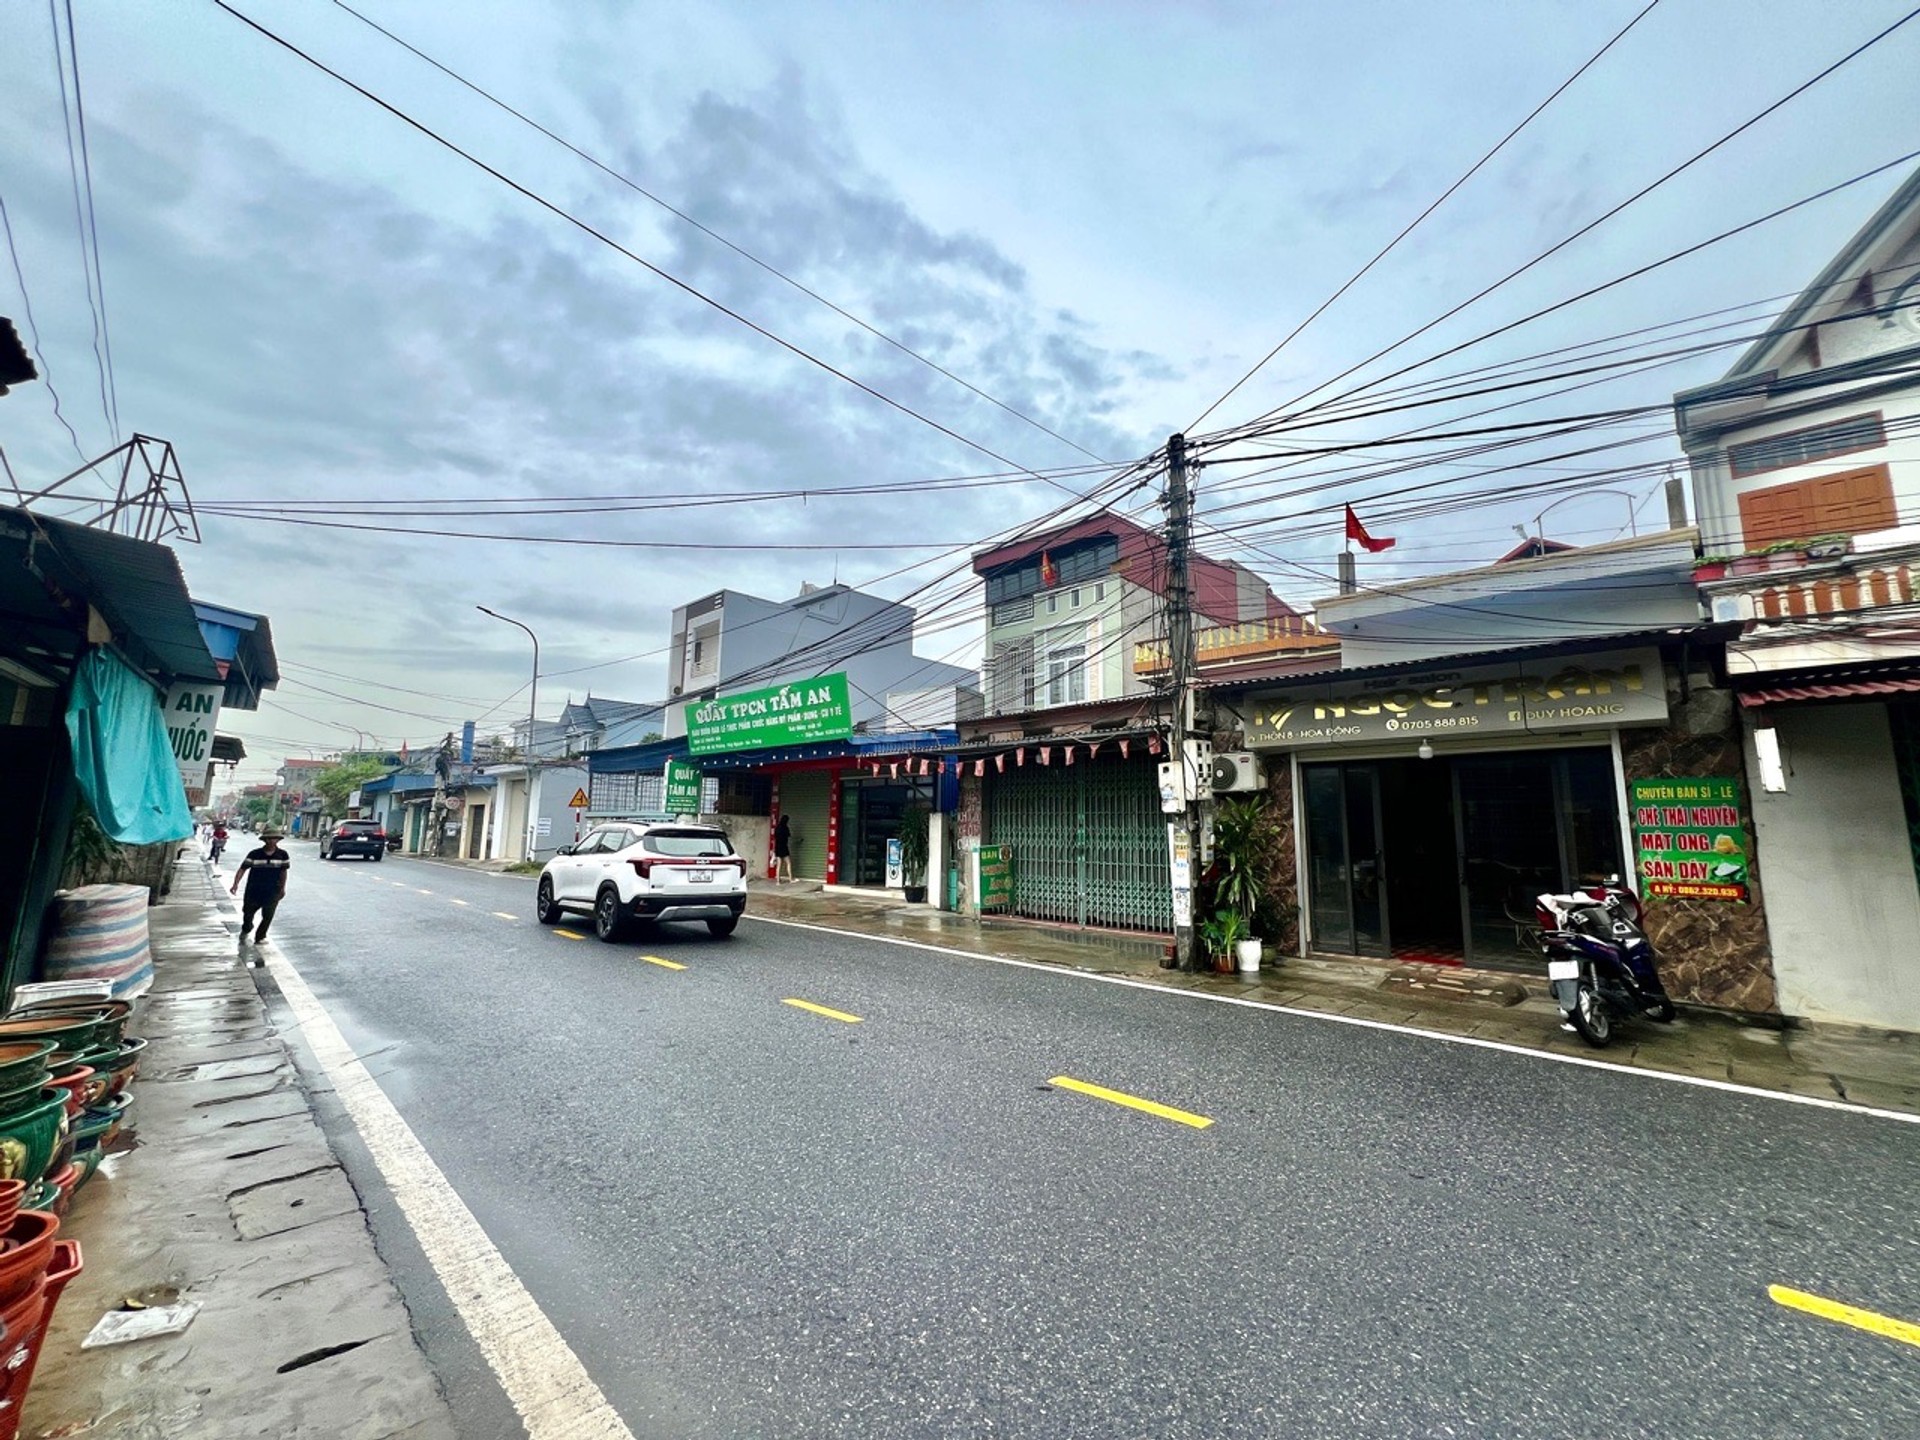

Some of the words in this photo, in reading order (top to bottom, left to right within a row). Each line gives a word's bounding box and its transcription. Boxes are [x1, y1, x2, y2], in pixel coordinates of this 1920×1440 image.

[175, 691, 214, 714] AN
[731, 698, 768, 719] TPCN
[807, 685, 832, 706] AN
[1401, 720, 1432, 731] 0705
[1434, 718, 1456, 728] 888
[1459, 716, 1479, 727] 815
[1526, 709, 1556, 721] DUY
[1636, 784, 1674, 799] CHUYÊN
[1661, 804, 1690, 827] THÁI
[1690, 803, 1739, 827] NGUYÊN
[1676, 833, 1711, 853] ONG
[1678, 858, 1709, 880] DÂY
